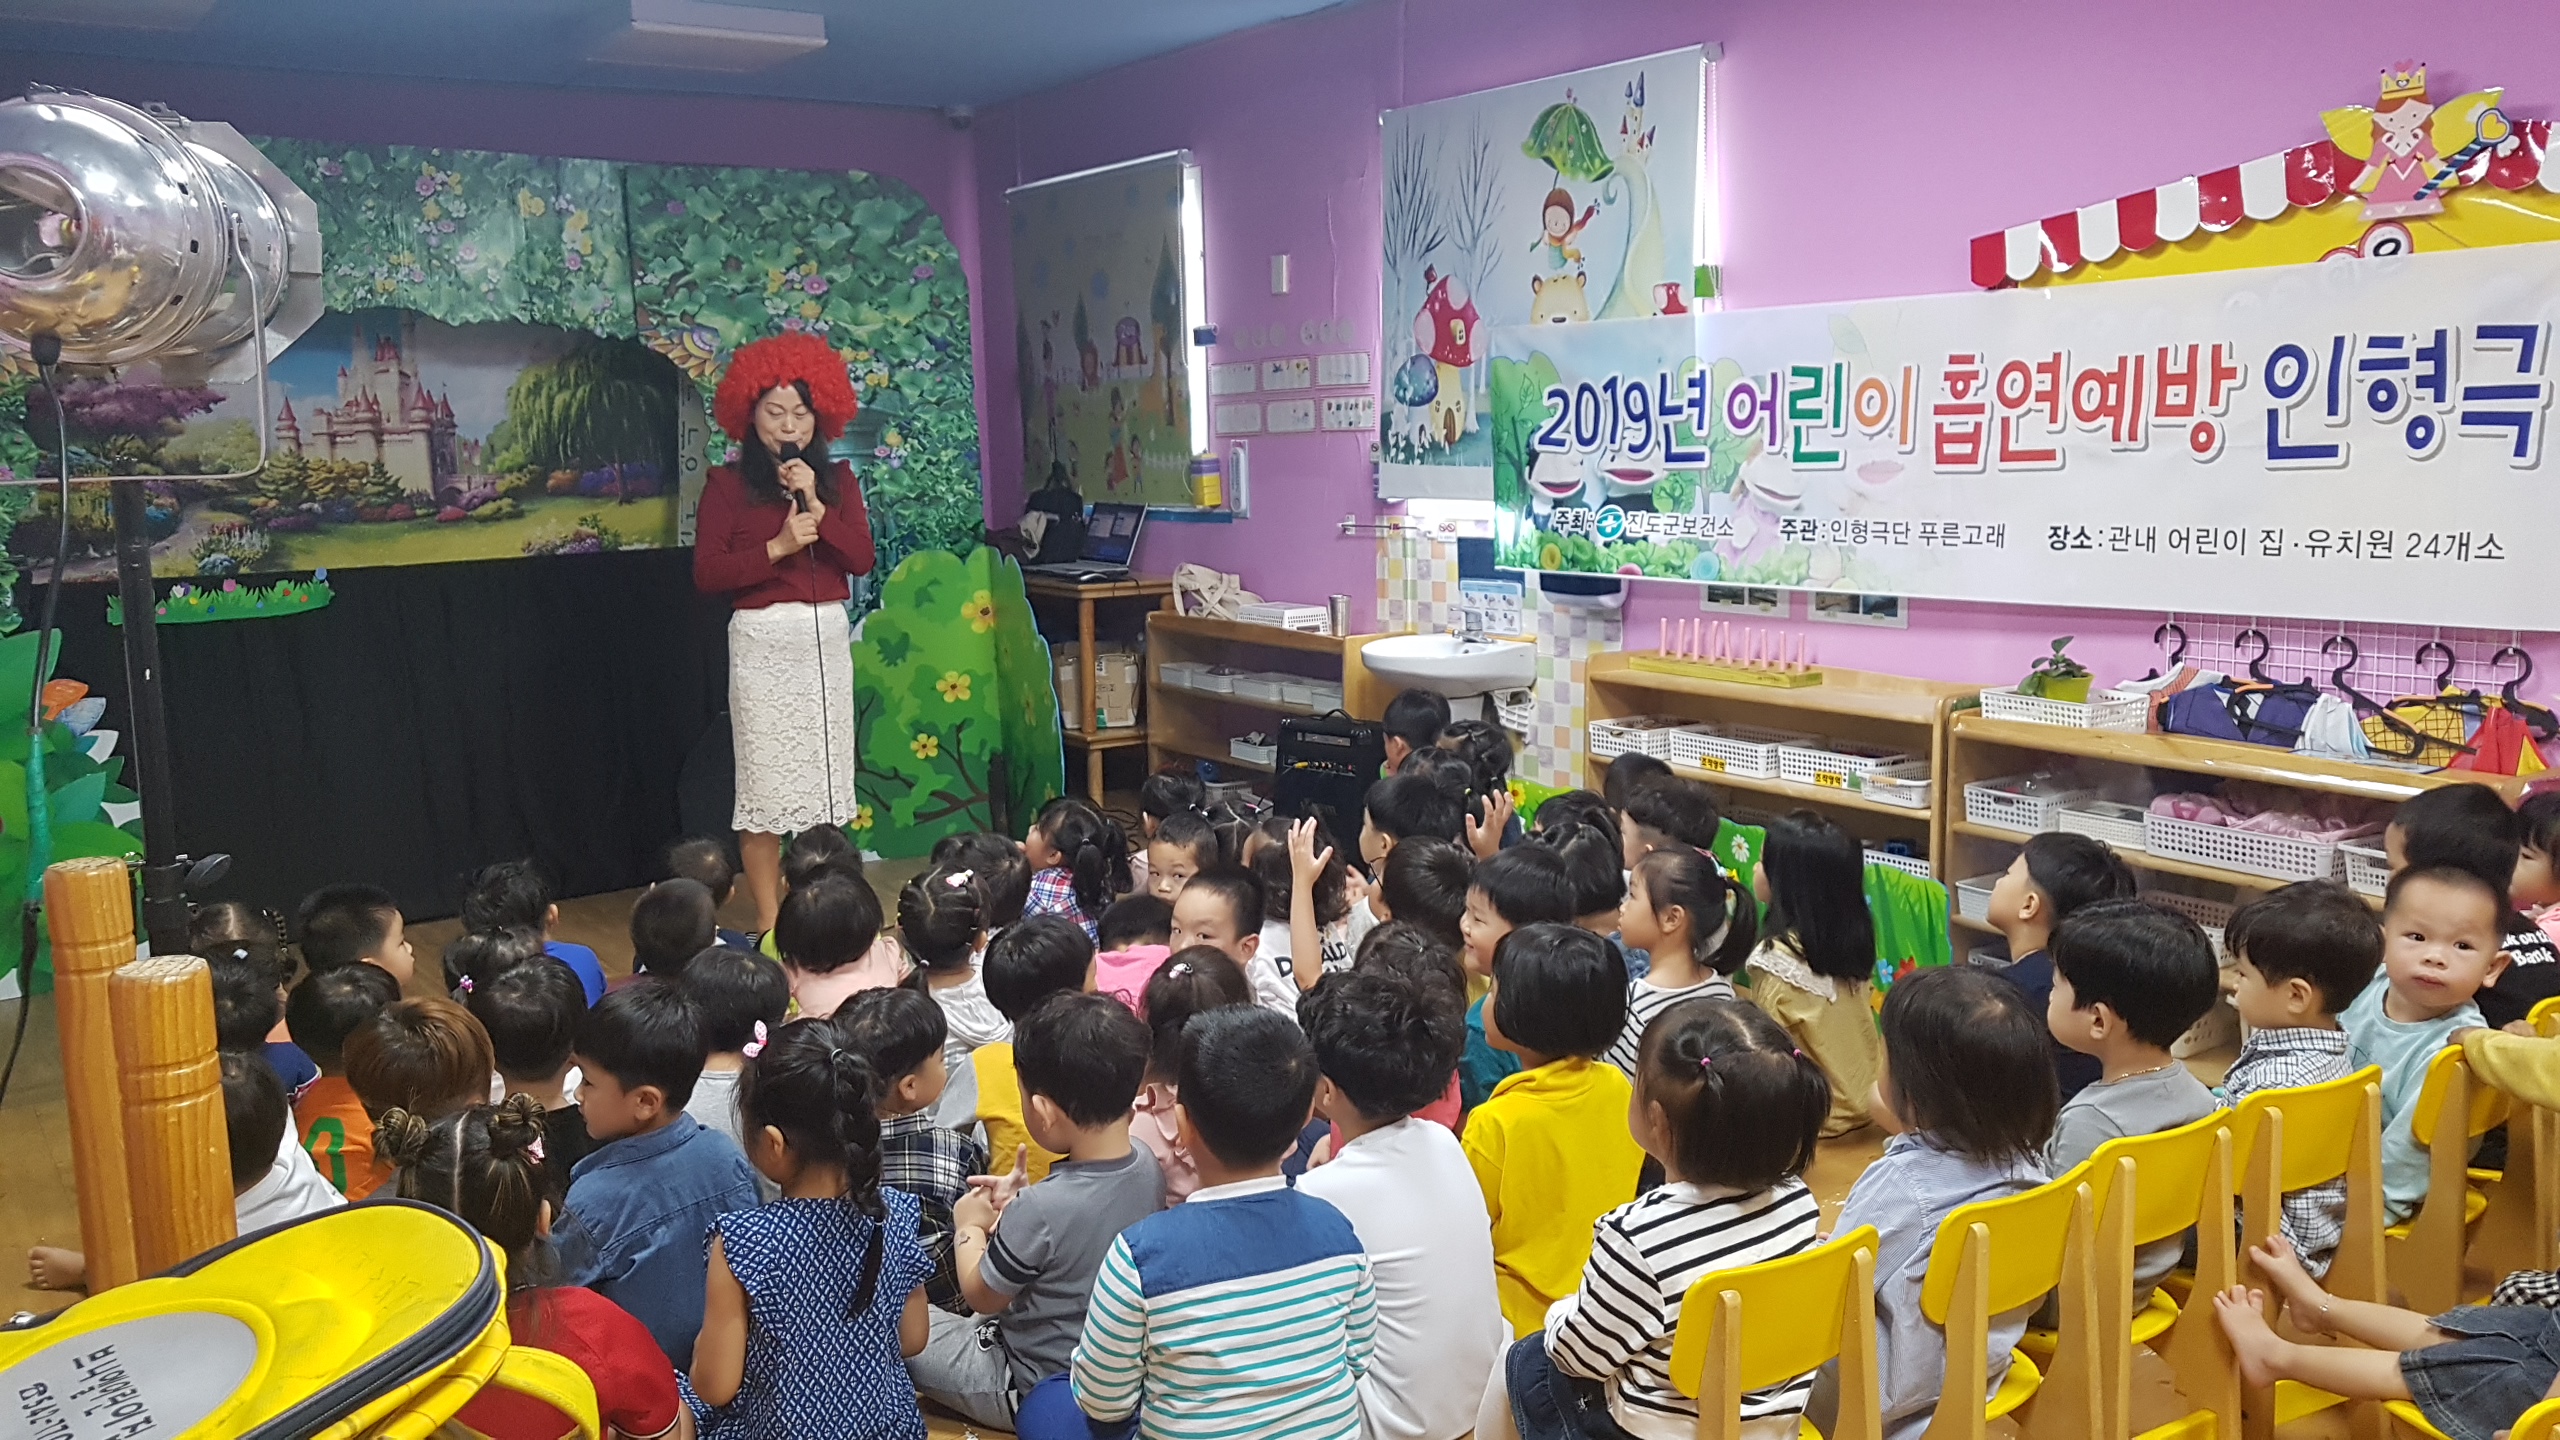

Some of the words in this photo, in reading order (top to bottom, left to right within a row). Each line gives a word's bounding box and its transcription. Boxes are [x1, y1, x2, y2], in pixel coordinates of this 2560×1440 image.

[1535, 367, 1707, 464] 2019년
[1727, 362, 1912, 464] 어린이
[1933, 342, 2238, 467] 흡연예방
[2264, 323, 2541, 461] 인형극
[1626, 512, 1734, 538] 진도군보건소
[1917, 521, 2006, 549] 푸른고래
[2167, 526, 2248, 557] 어린이
[2405, 530, 2506, 562] 24개소
[2519, 932, 2539, 945] on
[1275, 942, 1347, 977] DALD
[2510, 946, 2555, 966] Bank
